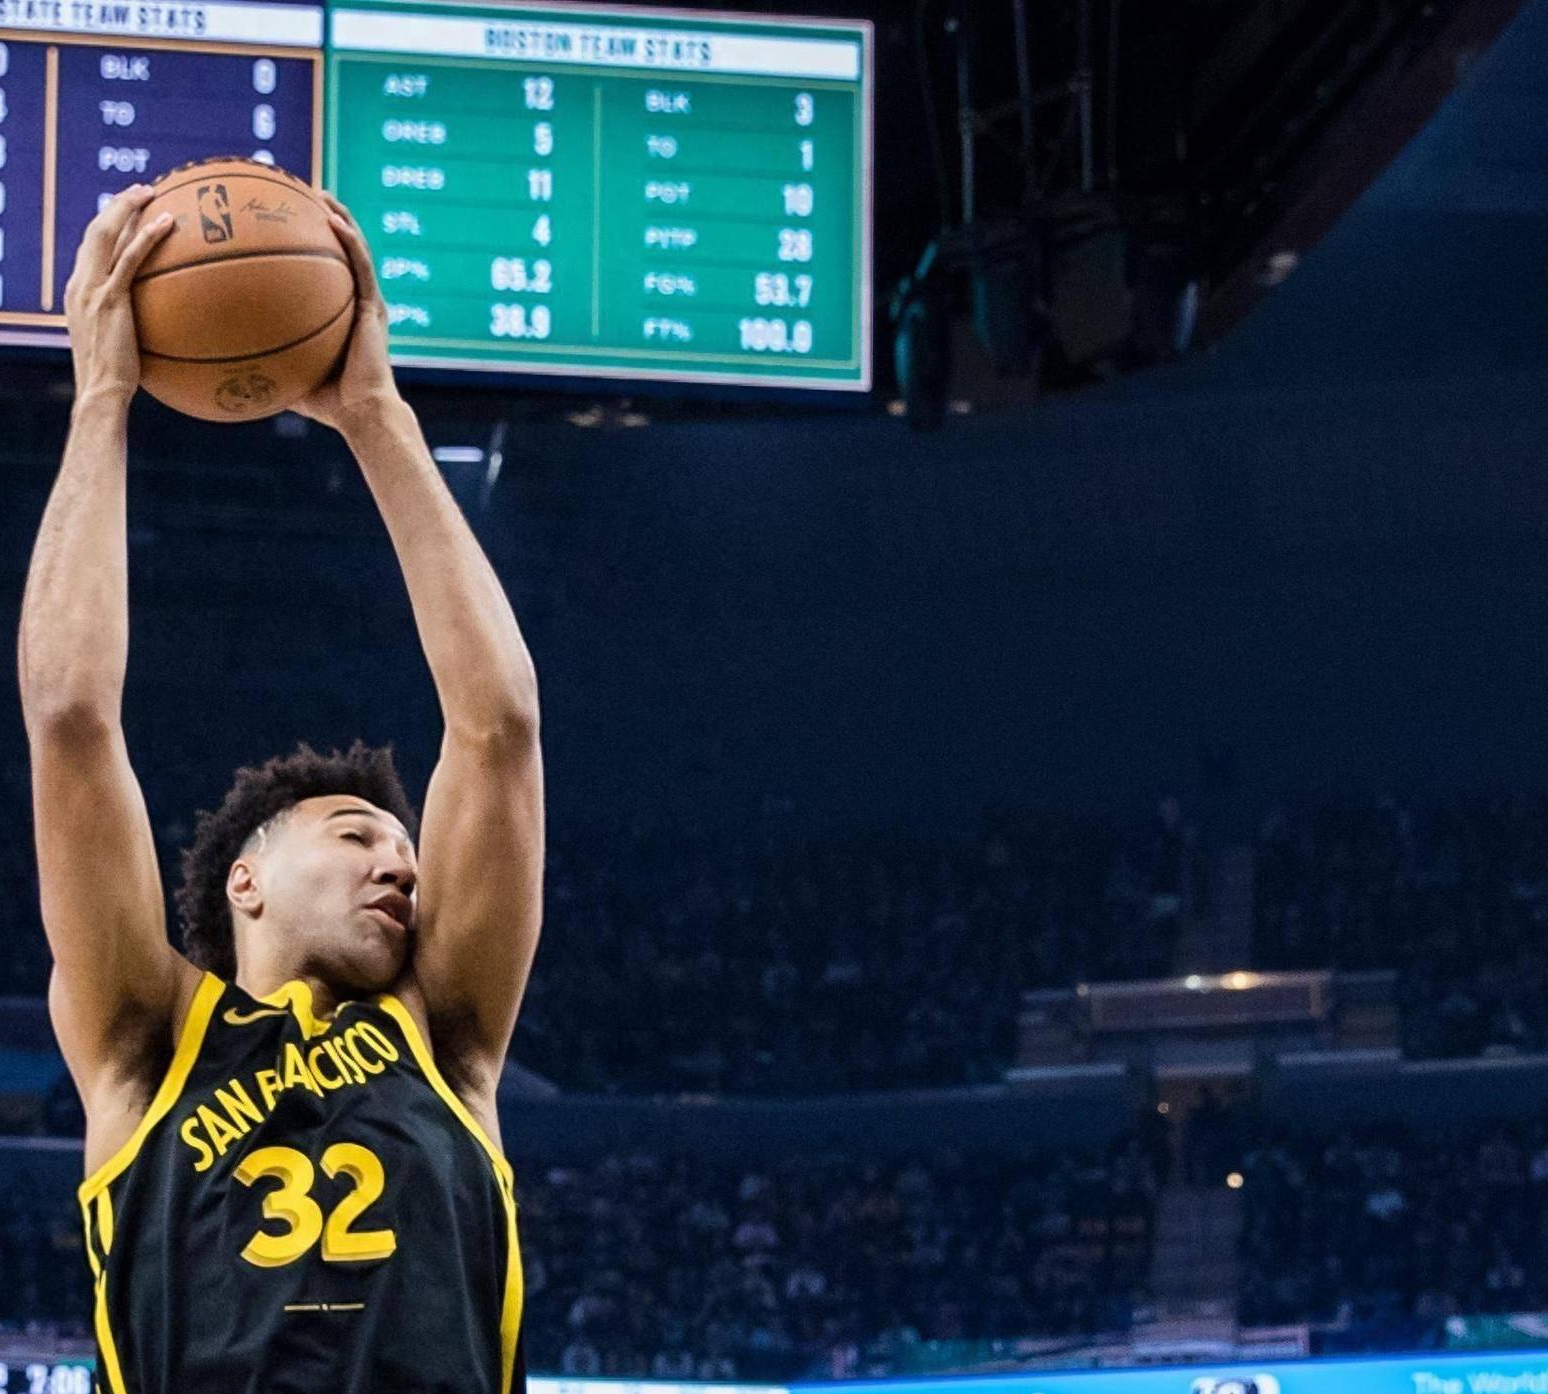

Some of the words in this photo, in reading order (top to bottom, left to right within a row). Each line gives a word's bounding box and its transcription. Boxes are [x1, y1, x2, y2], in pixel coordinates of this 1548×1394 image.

[69, 4, 130, 27] TEAM
[137, 7, 206, 34] STATS
[485, 27, 571, 52] BOSTON
[580, 33, 638, 58] TEAM
[645, 38, 713, 66] STATS
[101, 54, 150, 81] BLK
[383, 74, 431, 97] AST
[524, 76, 554, 110] 12
[645, 89, 692, 114] BLK
[795, 92, 814, 126] 3
[99, 100, 136, 126] TO
[381, 119, 447, 144] OREB
[99, 146, 150, 173] POT
[646, 134, 678, 159] TO
[800, 139, 814, 172] 1
[381, 164, 445, 190] DREB
[527, 168, 552, 201] 11
[645, 180, 690, 206] POT
[783, 182, 814, 217] 10
[381, 210, 422, 236] STL
[531, 213, 551, 248] 4
[778, 228, 813, 262] 28
[643, 271, 696, 296] FG%
[755, 272, 813, 308] 53.7
[643, 317, 693, 342] FT%
[739, 317, 813, 354] 100.0
[180, 1079, 267, 1172] SAN
[234, 1142, 398, 1269] 32
